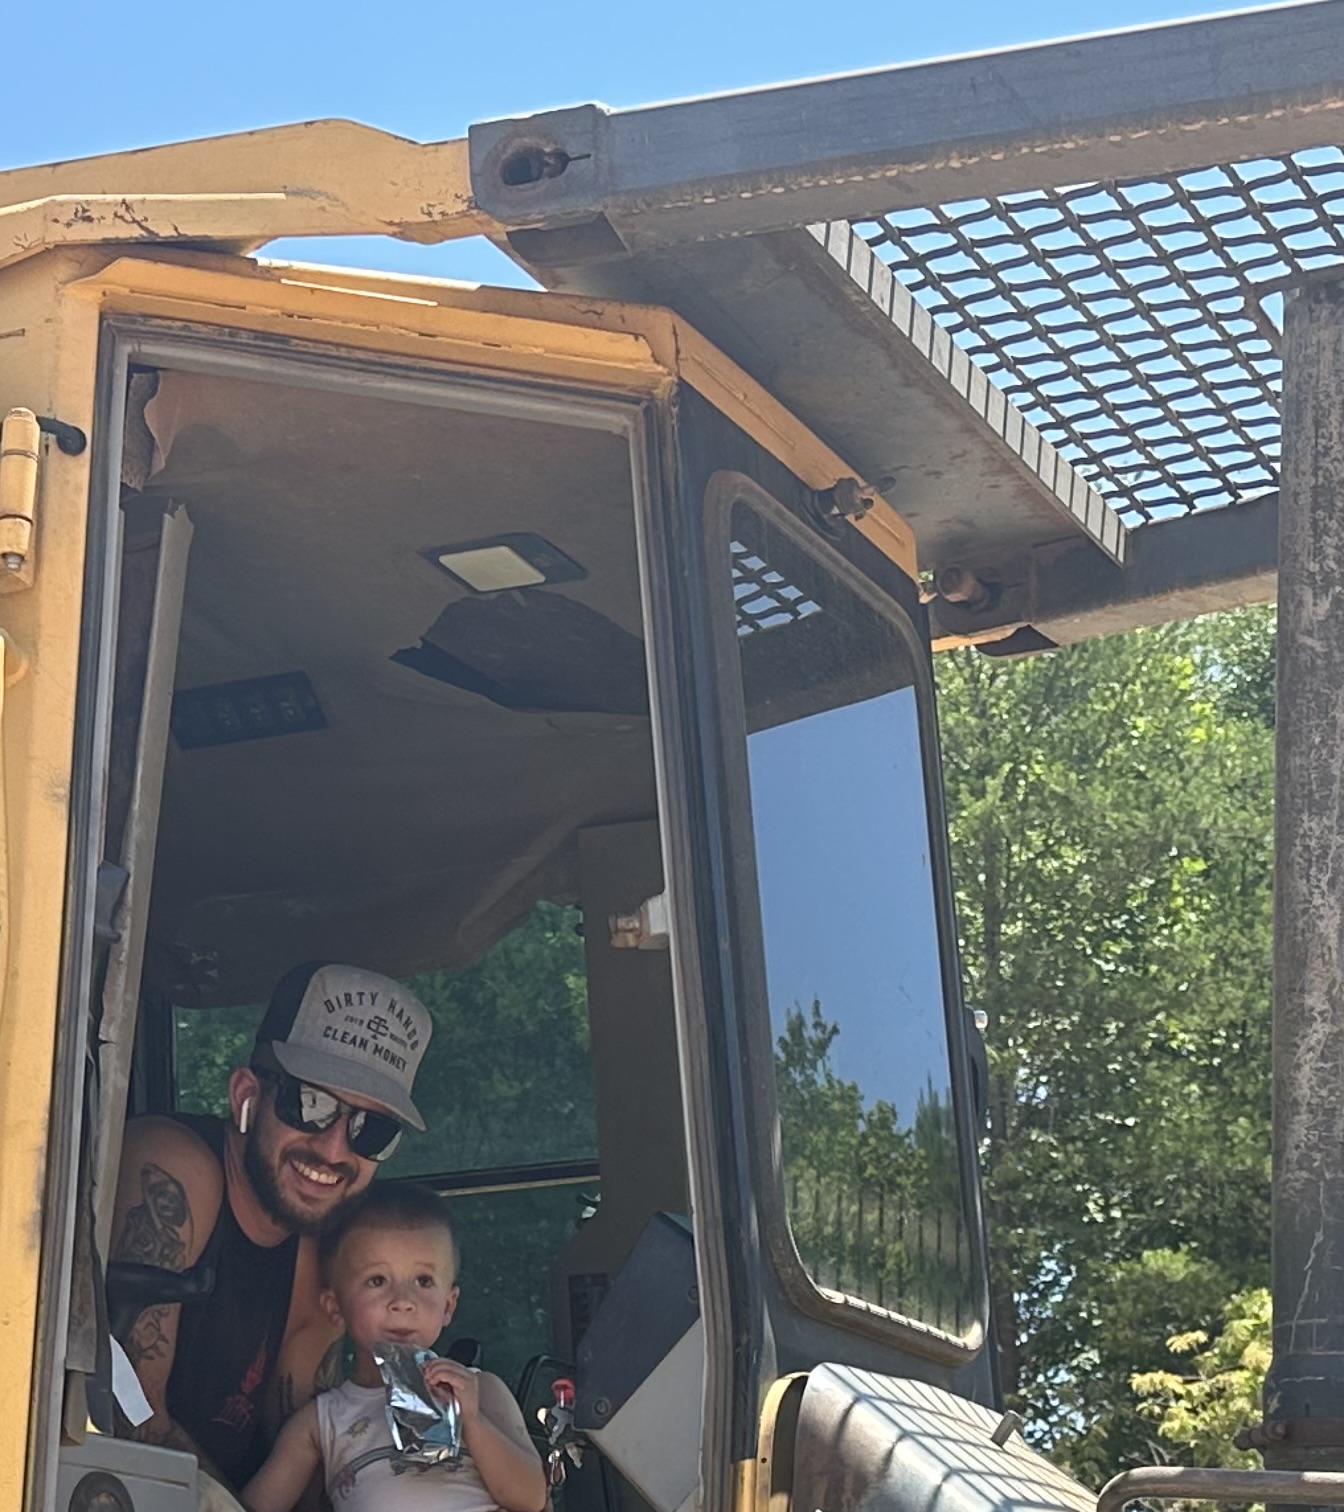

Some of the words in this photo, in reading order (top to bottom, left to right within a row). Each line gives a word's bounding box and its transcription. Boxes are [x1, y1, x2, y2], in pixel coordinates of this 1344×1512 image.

[324, 991, 379, 1014] DIRTY
[387, 998, 419, 1051] HANDS
[322, 1025, 370, 1052] CLEAN
[372, 1043, 408, 1073] MONEY
